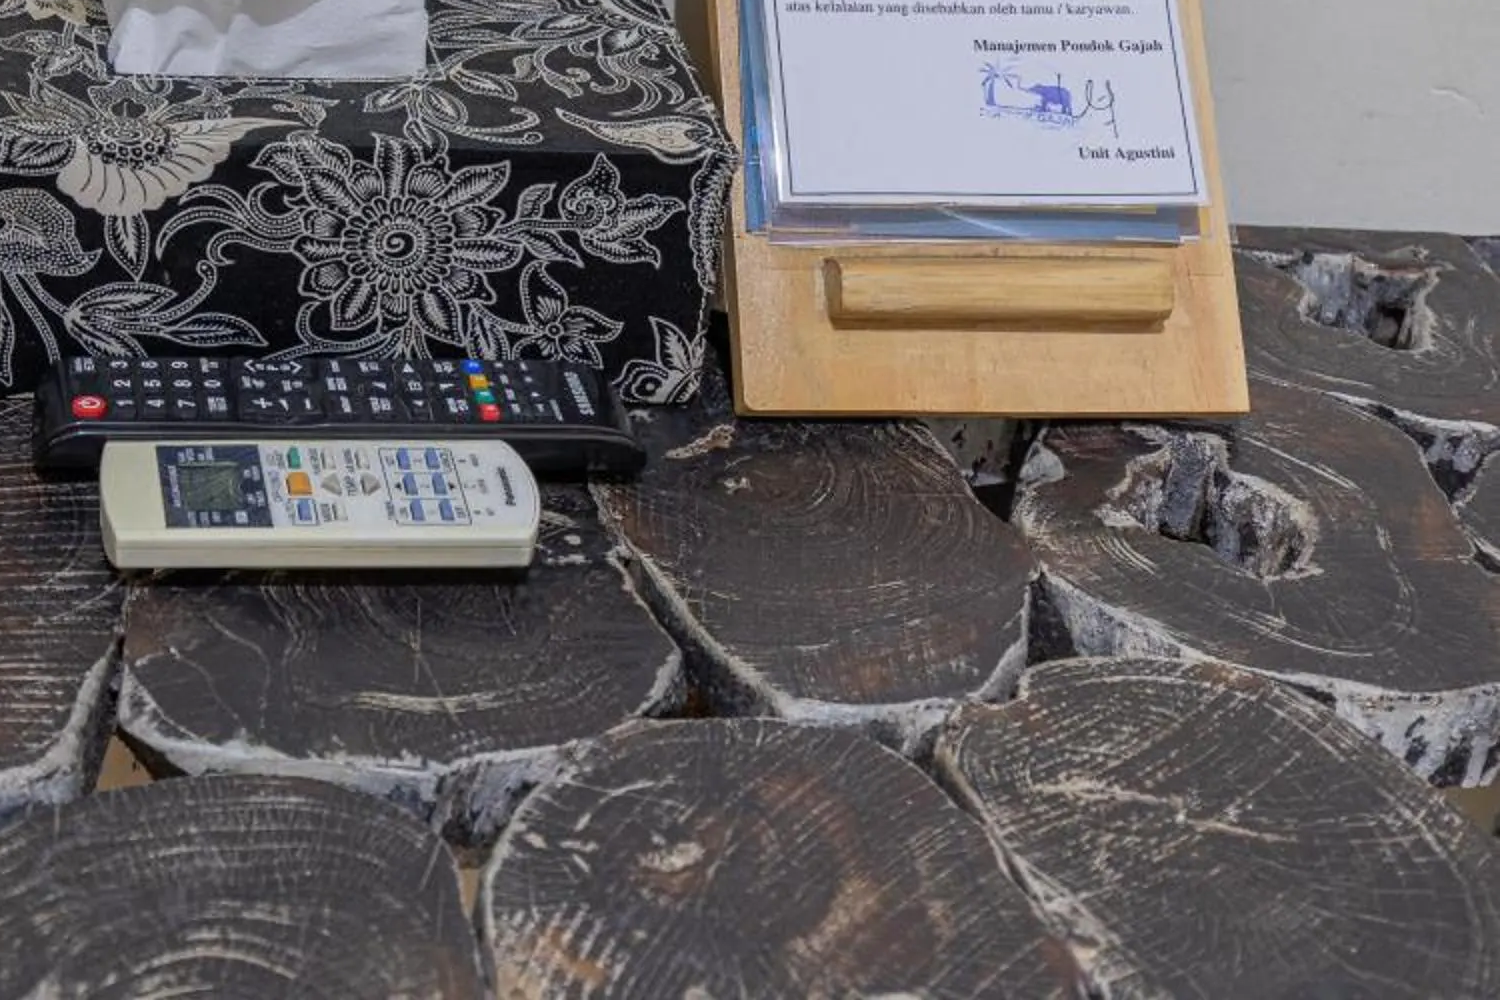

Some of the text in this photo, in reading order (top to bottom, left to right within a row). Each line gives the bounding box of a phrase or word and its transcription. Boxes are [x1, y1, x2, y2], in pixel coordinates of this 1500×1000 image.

[785, 1, 811, 13] atas
[877, 3, 908, 16] yang
[989, 2, 1018, 15] oleh
[1021, 3, 1054, 15] tamu
[973, 39, 1163, 54] Manajemen Pondok Gajah
[1078, 146, 1175, 161] Unit Agustini
[110, 359, 135, 407] 1 2 3
[140, 359, 164, 408] 4 5 6
[171, 360, 196, 409] 7 8 9
[203, 379, 221, 389] 0
[563, 371, 595, 416] SAMSUNG
[496, 466, 516, 507] Panasonic
